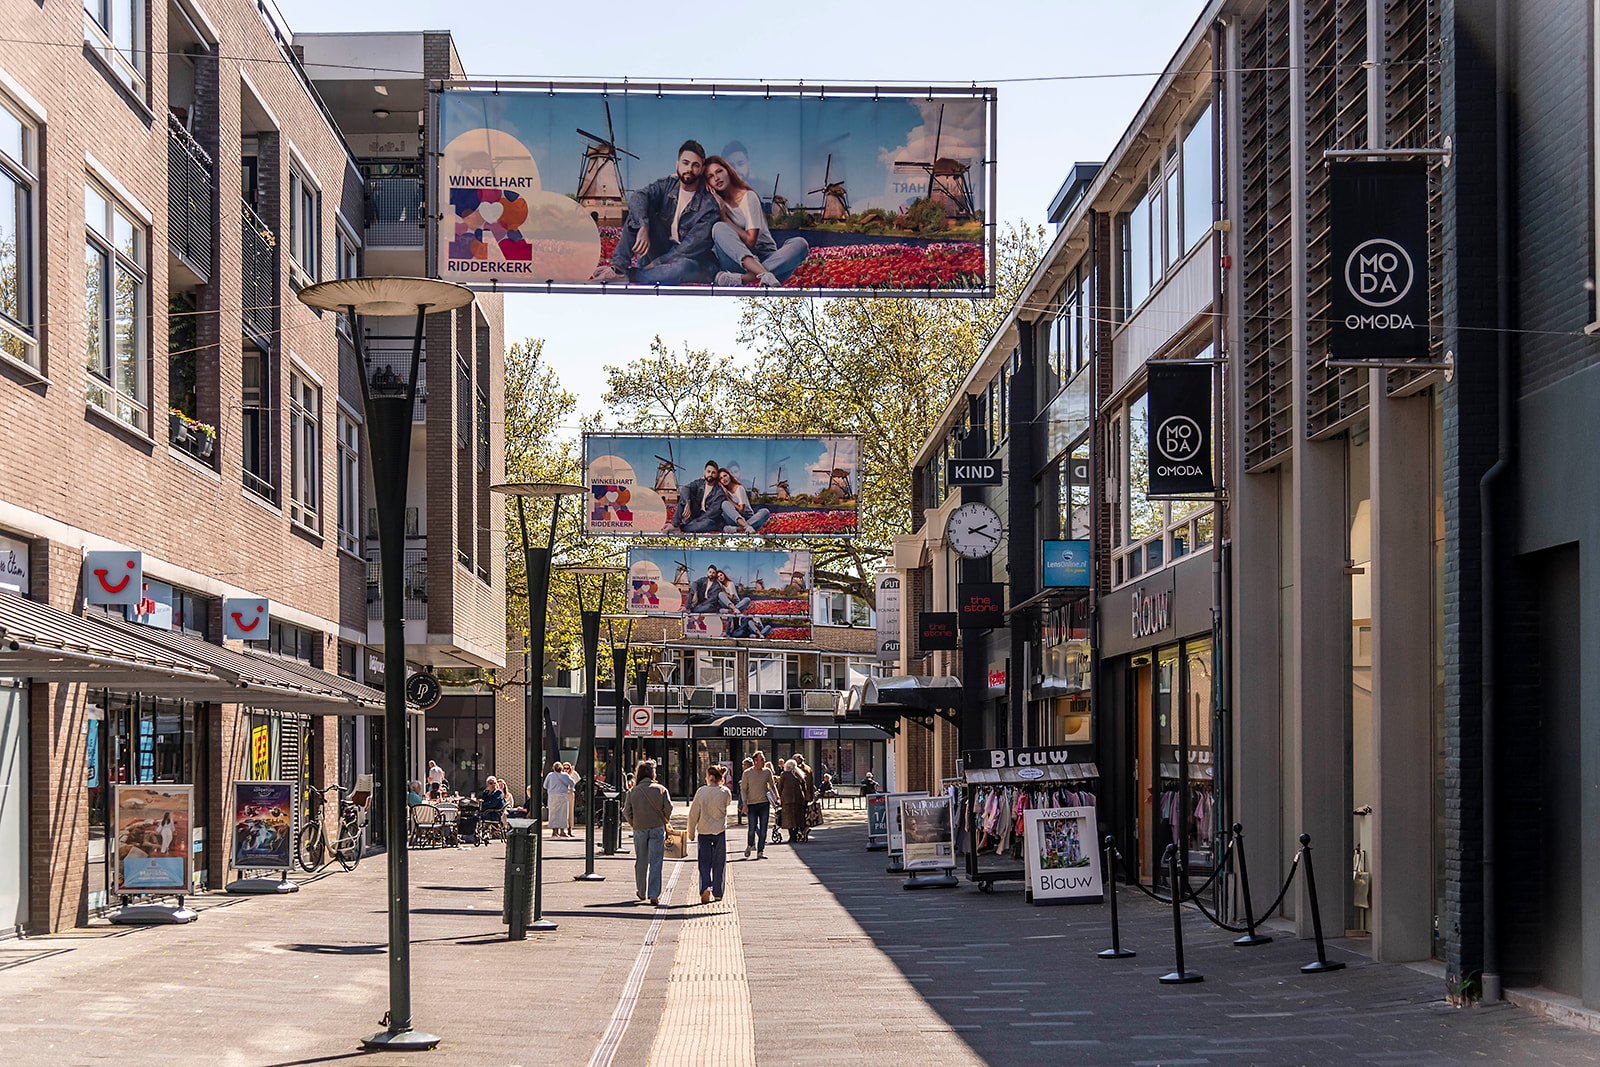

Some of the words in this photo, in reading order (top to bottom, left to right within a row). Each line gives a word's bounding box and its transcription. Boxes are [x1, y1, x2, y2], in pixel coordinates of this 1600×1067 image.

[449, 176, 533, 188] WINKELHART
[448, 261, 533, 273] RIDDERKERK
[1345, 314, 1414, 329] OMODA
[955, 466, 994, 478] KIND
[1157, 466, 1203, 476] OMODA
[1132, 587, 1168, 639] Blauw
[723, 727, 768, 737] RIDDERHOF
[990, 750, 1068, 768] Blauw
[874, 811, 886, 822] 1/
[1041, 875, 1093, 890] Blauw
